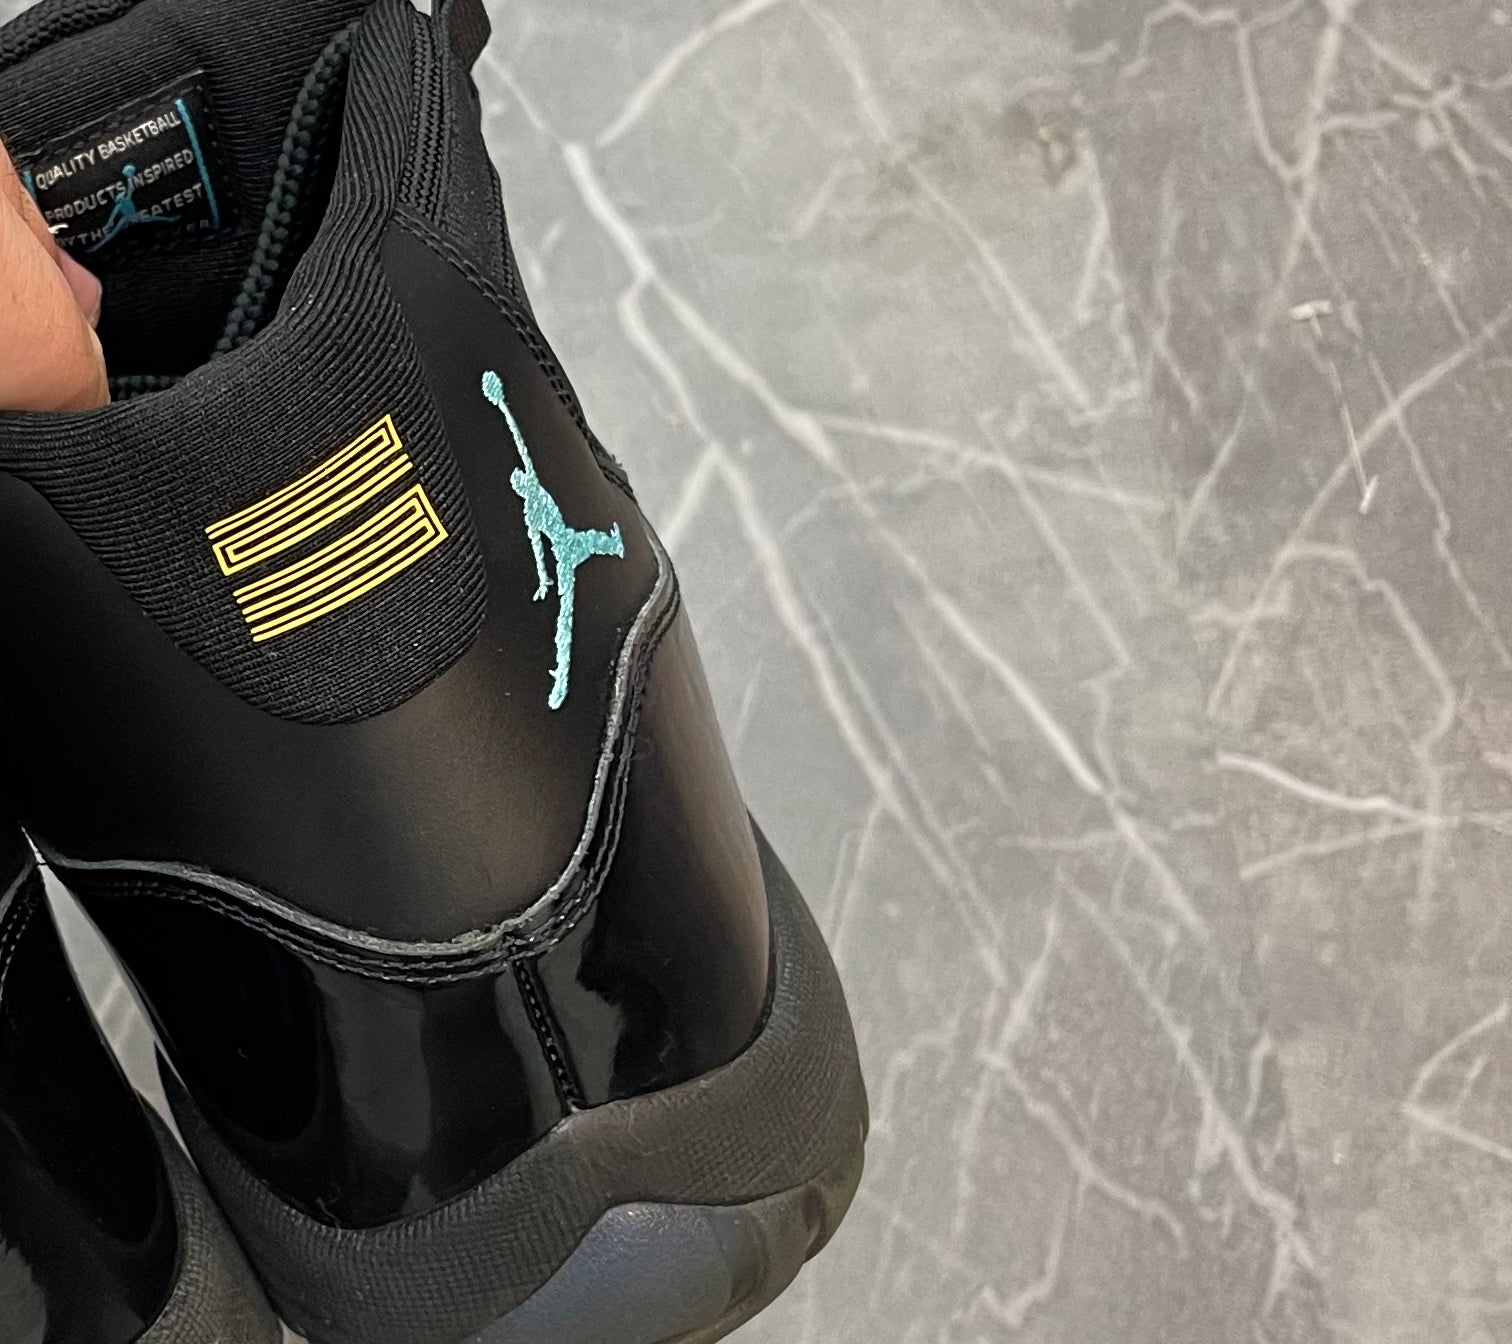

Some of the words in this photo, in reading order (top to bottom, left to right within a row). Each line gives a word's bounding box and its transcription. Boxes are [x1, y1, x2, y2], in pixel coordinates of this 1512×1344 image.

[35, 149, 95, 191] QUALITY
[97, 111, 182, 160] BASKETBALL
[44, 180, 126, 224] PRODUCTS
[130, 181, 202, 220] EATEST
